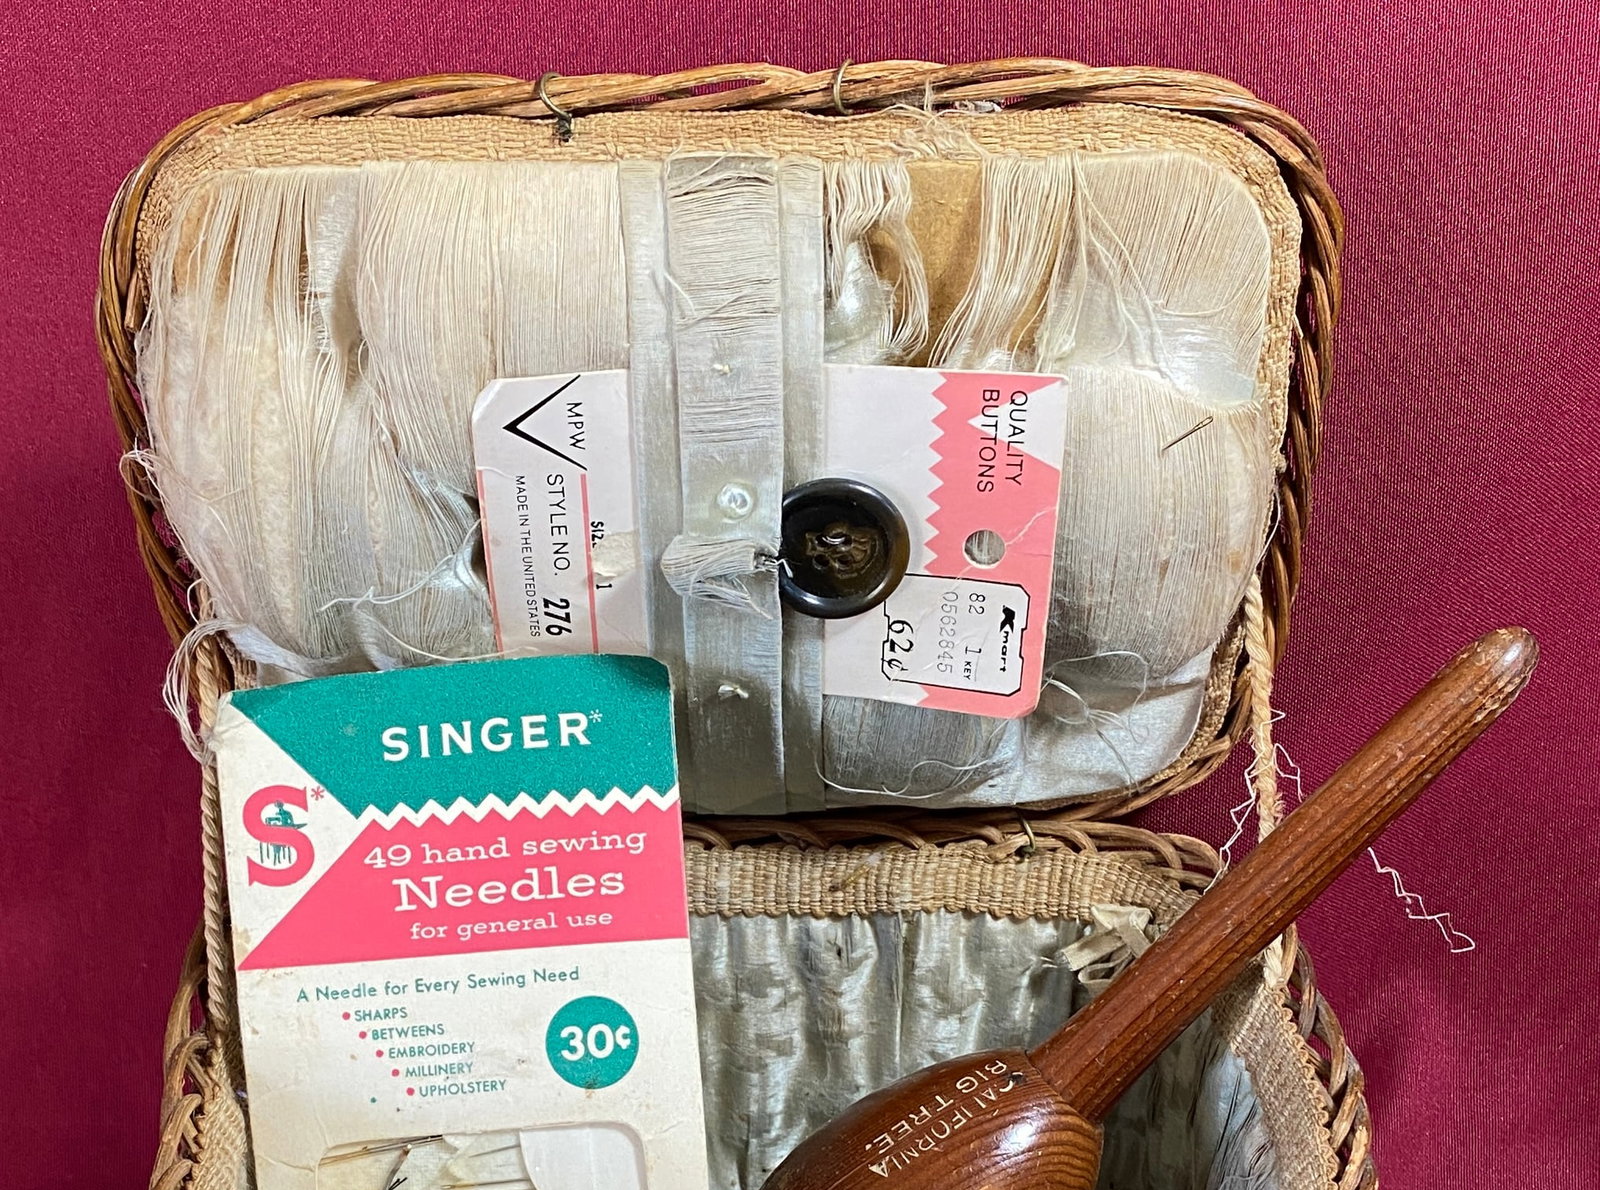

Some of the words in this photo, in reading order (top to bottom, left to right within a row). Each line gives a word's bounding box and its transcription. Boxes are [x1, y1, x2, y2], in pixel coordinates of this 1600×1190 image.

[565, 401, 587, 451] MPW
[976, 388, 1001, 494] BUTTONS
[1005, 390, 1029, 487] QUALITY
[515, 475, 530, 512] MADE
[547, 473, 567, 537] STYLE
[518, 513, 531, 527] IN
[590, 520, 605, 549] SIZ
[520, 529, 532, 554] THE
[553, 541, 571, 577] NO.
[522, 555, 537, 598] UNITED
[526, 598, 541, 638] STATES
[542, 597, 572, 637] 276
[968, 592, 985, 615] 82
[936, 591, 959, 674] 0562845
[963, 660, 973, 681] KEY
[363, 843, 412, 869] 49
[422, 837, 508, 865] hand
[522, 830, 648, 858] sewing
[392, 866, 626, 912] Needles
[409, 922, 448, 941] for
[456, 912, 558, 942] general
[566, 911, 614, 928] use
[296, 988, 311, 1003] A
[315, 981, 379, 1003] Needle
[384, 979, 409, 998] for
[414, 976, 461, 999] Every
[467, 971, 528, 995] Sewing
[533, 966, 580, 984] Need
[354, 1006, 409, 1022] SHARPS
[371, 1023, 446, 1042] BETWEENS
[387, 1041, 476, 1060] EMBROIDERY
[559, 1023, 632, 1062] 30¢
[404, 1061, 474, 1079] MILLINERY
[955, 1059, 1008, 1094] BIG
[418, 1079, 508, 1099] UPHOLSTERY
